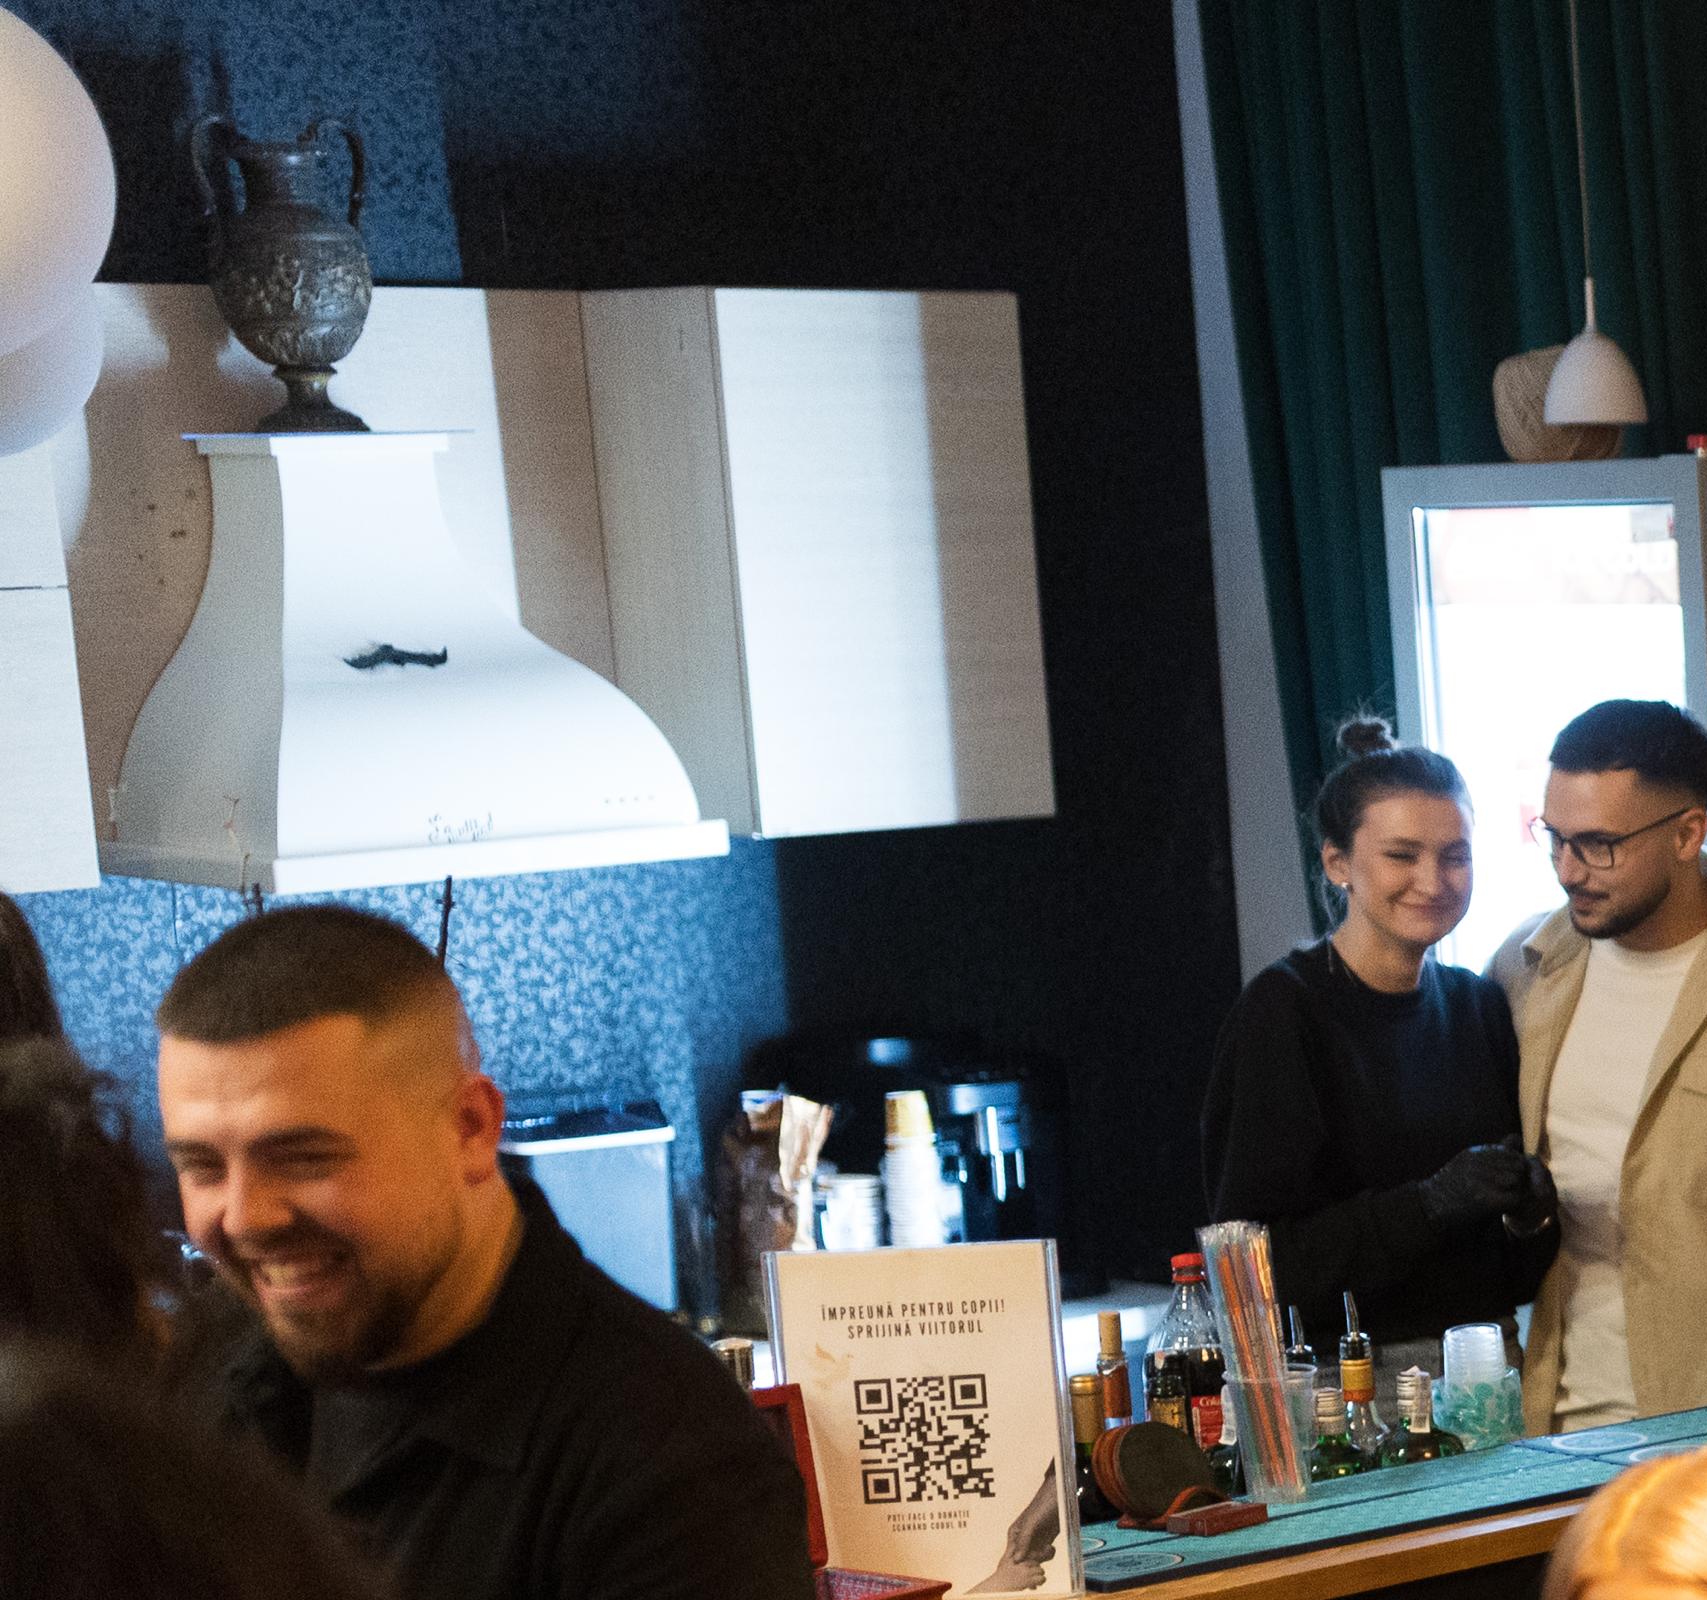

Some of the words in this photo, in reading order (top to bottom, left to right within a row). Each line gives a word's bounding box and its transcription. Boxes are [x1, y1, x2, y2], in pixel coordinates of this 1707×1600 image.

[901, 1301, 954, 1317] PENTRU
[961, 1299, 1005, 1315] COPII!
[919, 1319, 983, 1336] VIITORUL
